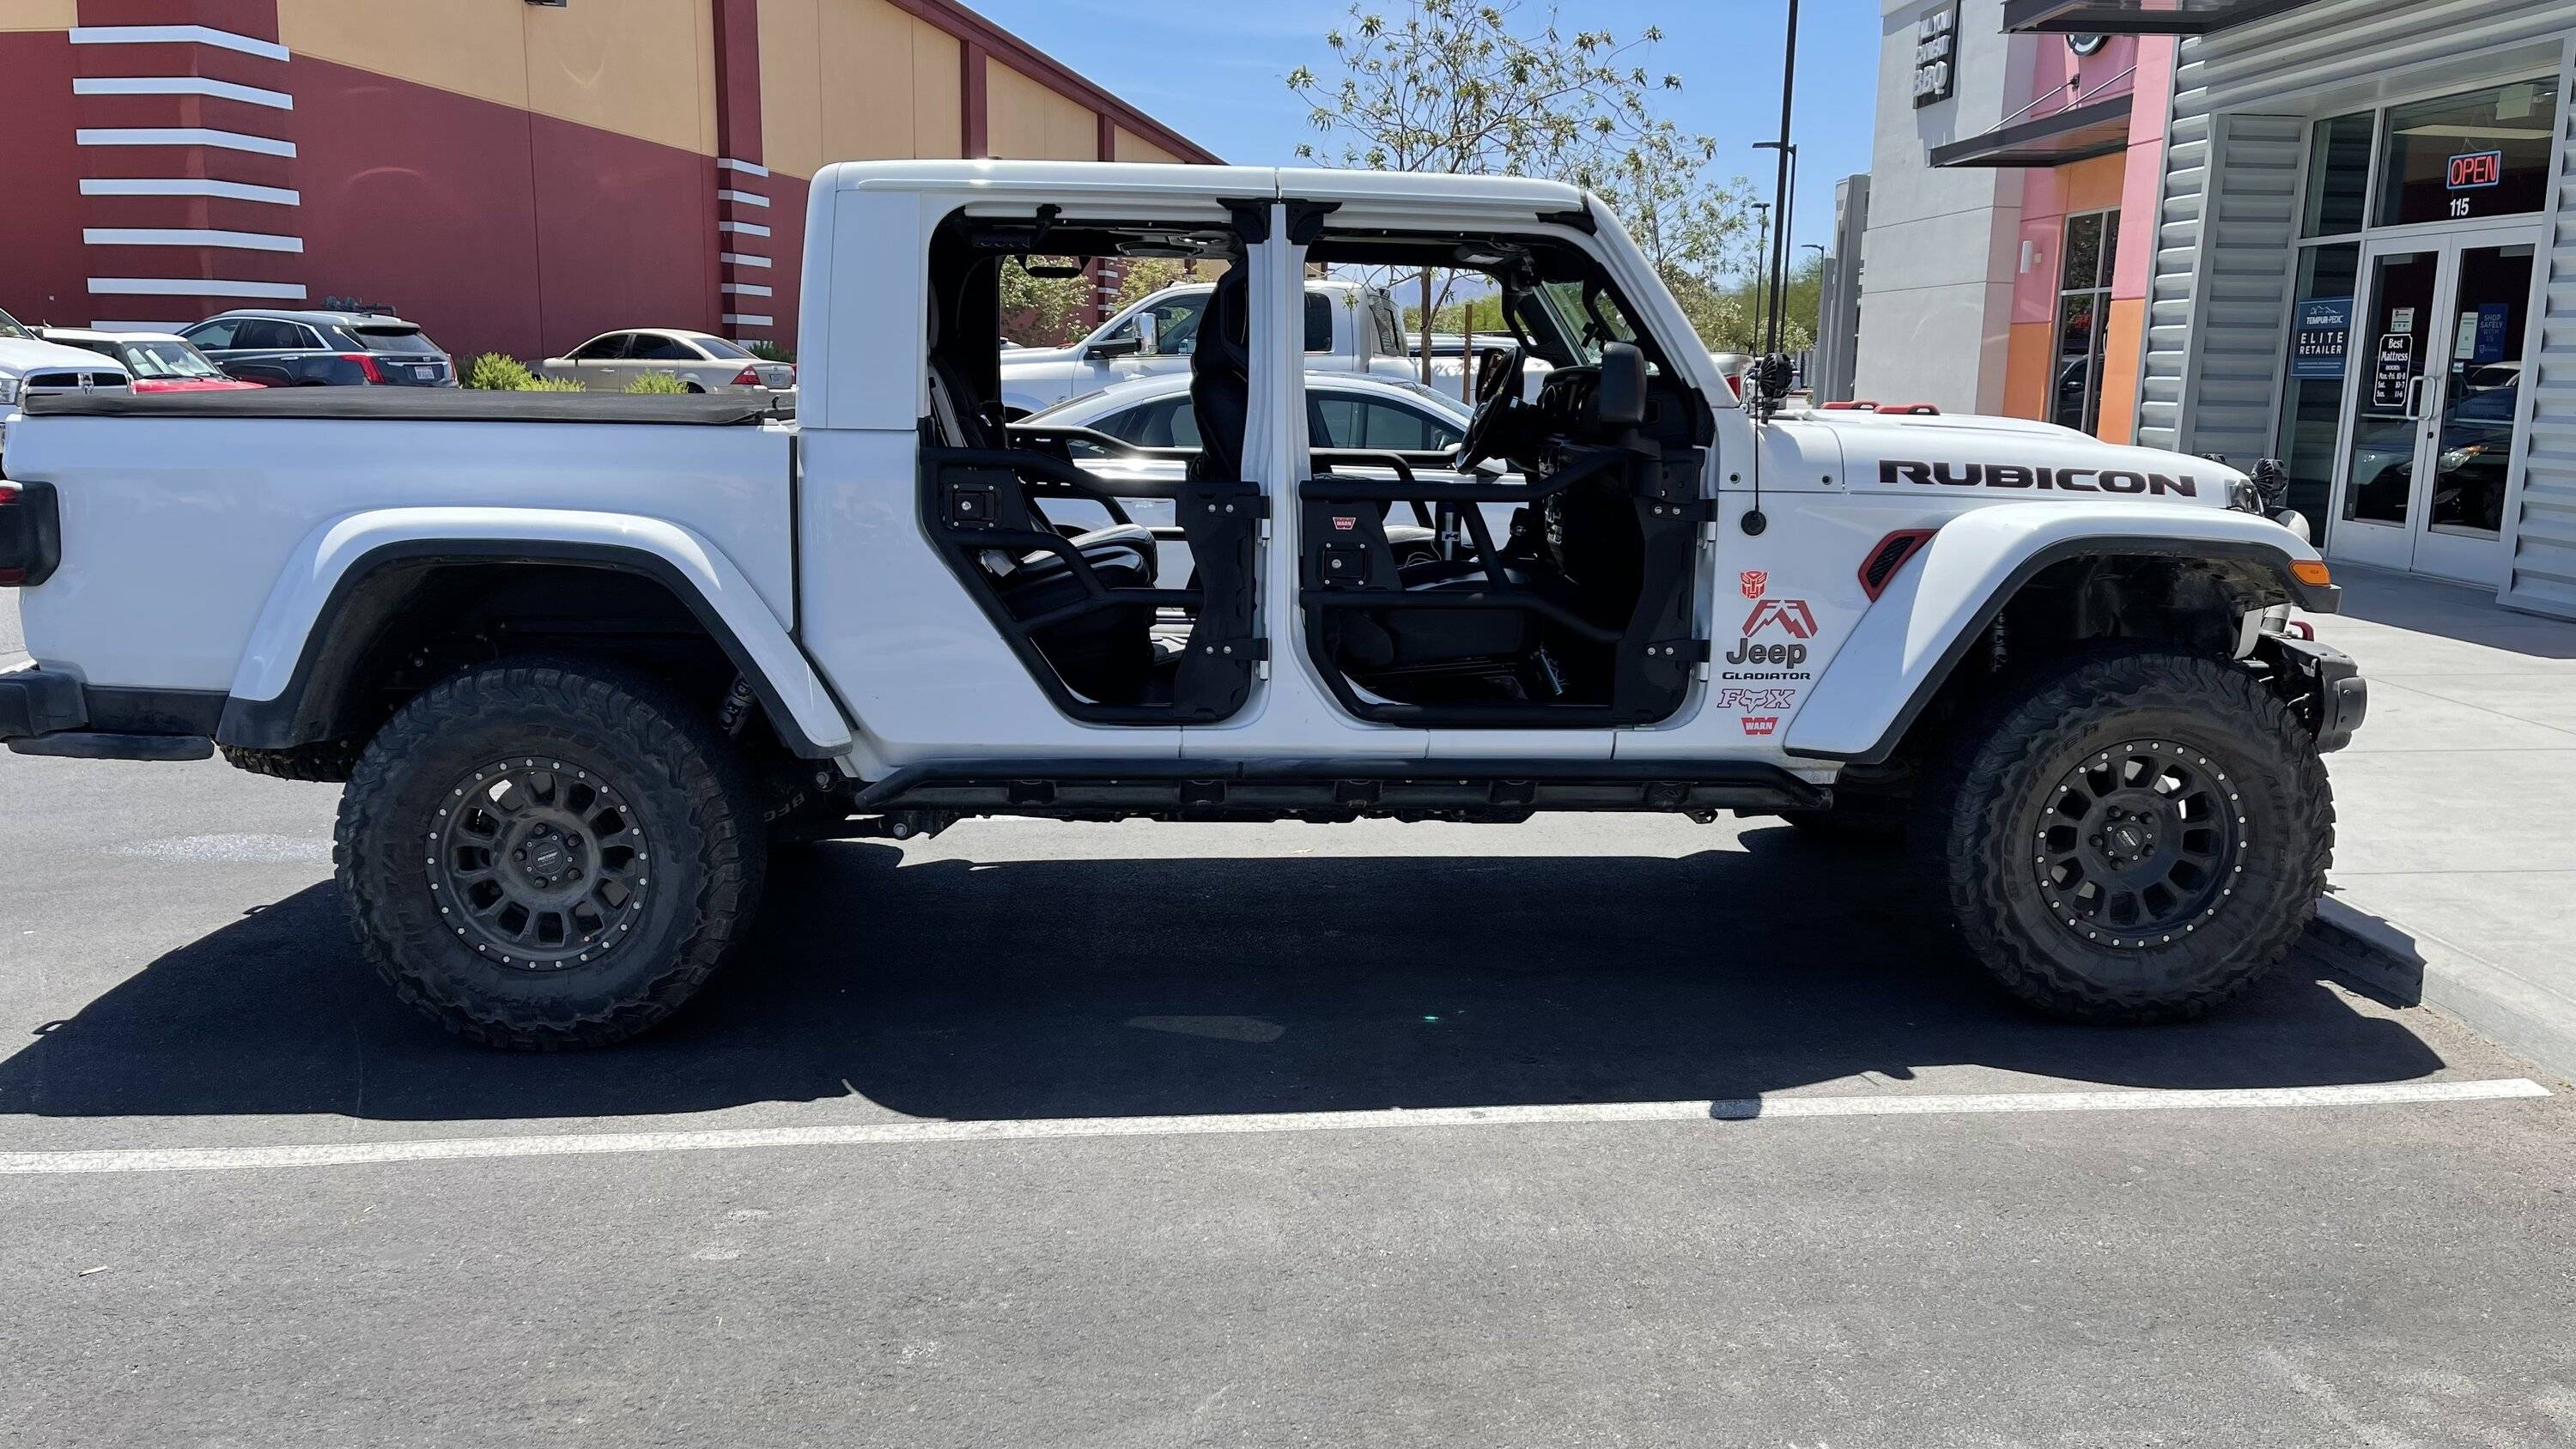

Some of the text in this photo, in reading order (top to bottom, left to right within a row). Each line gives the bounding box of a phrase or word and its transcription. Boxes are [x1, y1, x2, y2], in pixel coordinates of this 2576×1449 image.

[1912, 61, 1947, 96] BBQ
[2451, 155, 2497, 185] OPEN
[2450, 197, 2470, 216] 115
[2301, 332, 2343, 343] ELITE
[2388, 338, 2403, 349] Best
[2300, 345, 2342, 354] RETAILER
[2381, 351, 2408, 361] Mattress
[1879, 460, 2197, 498] RUBICON
[1726, 638, 1807, 670] Jeep
